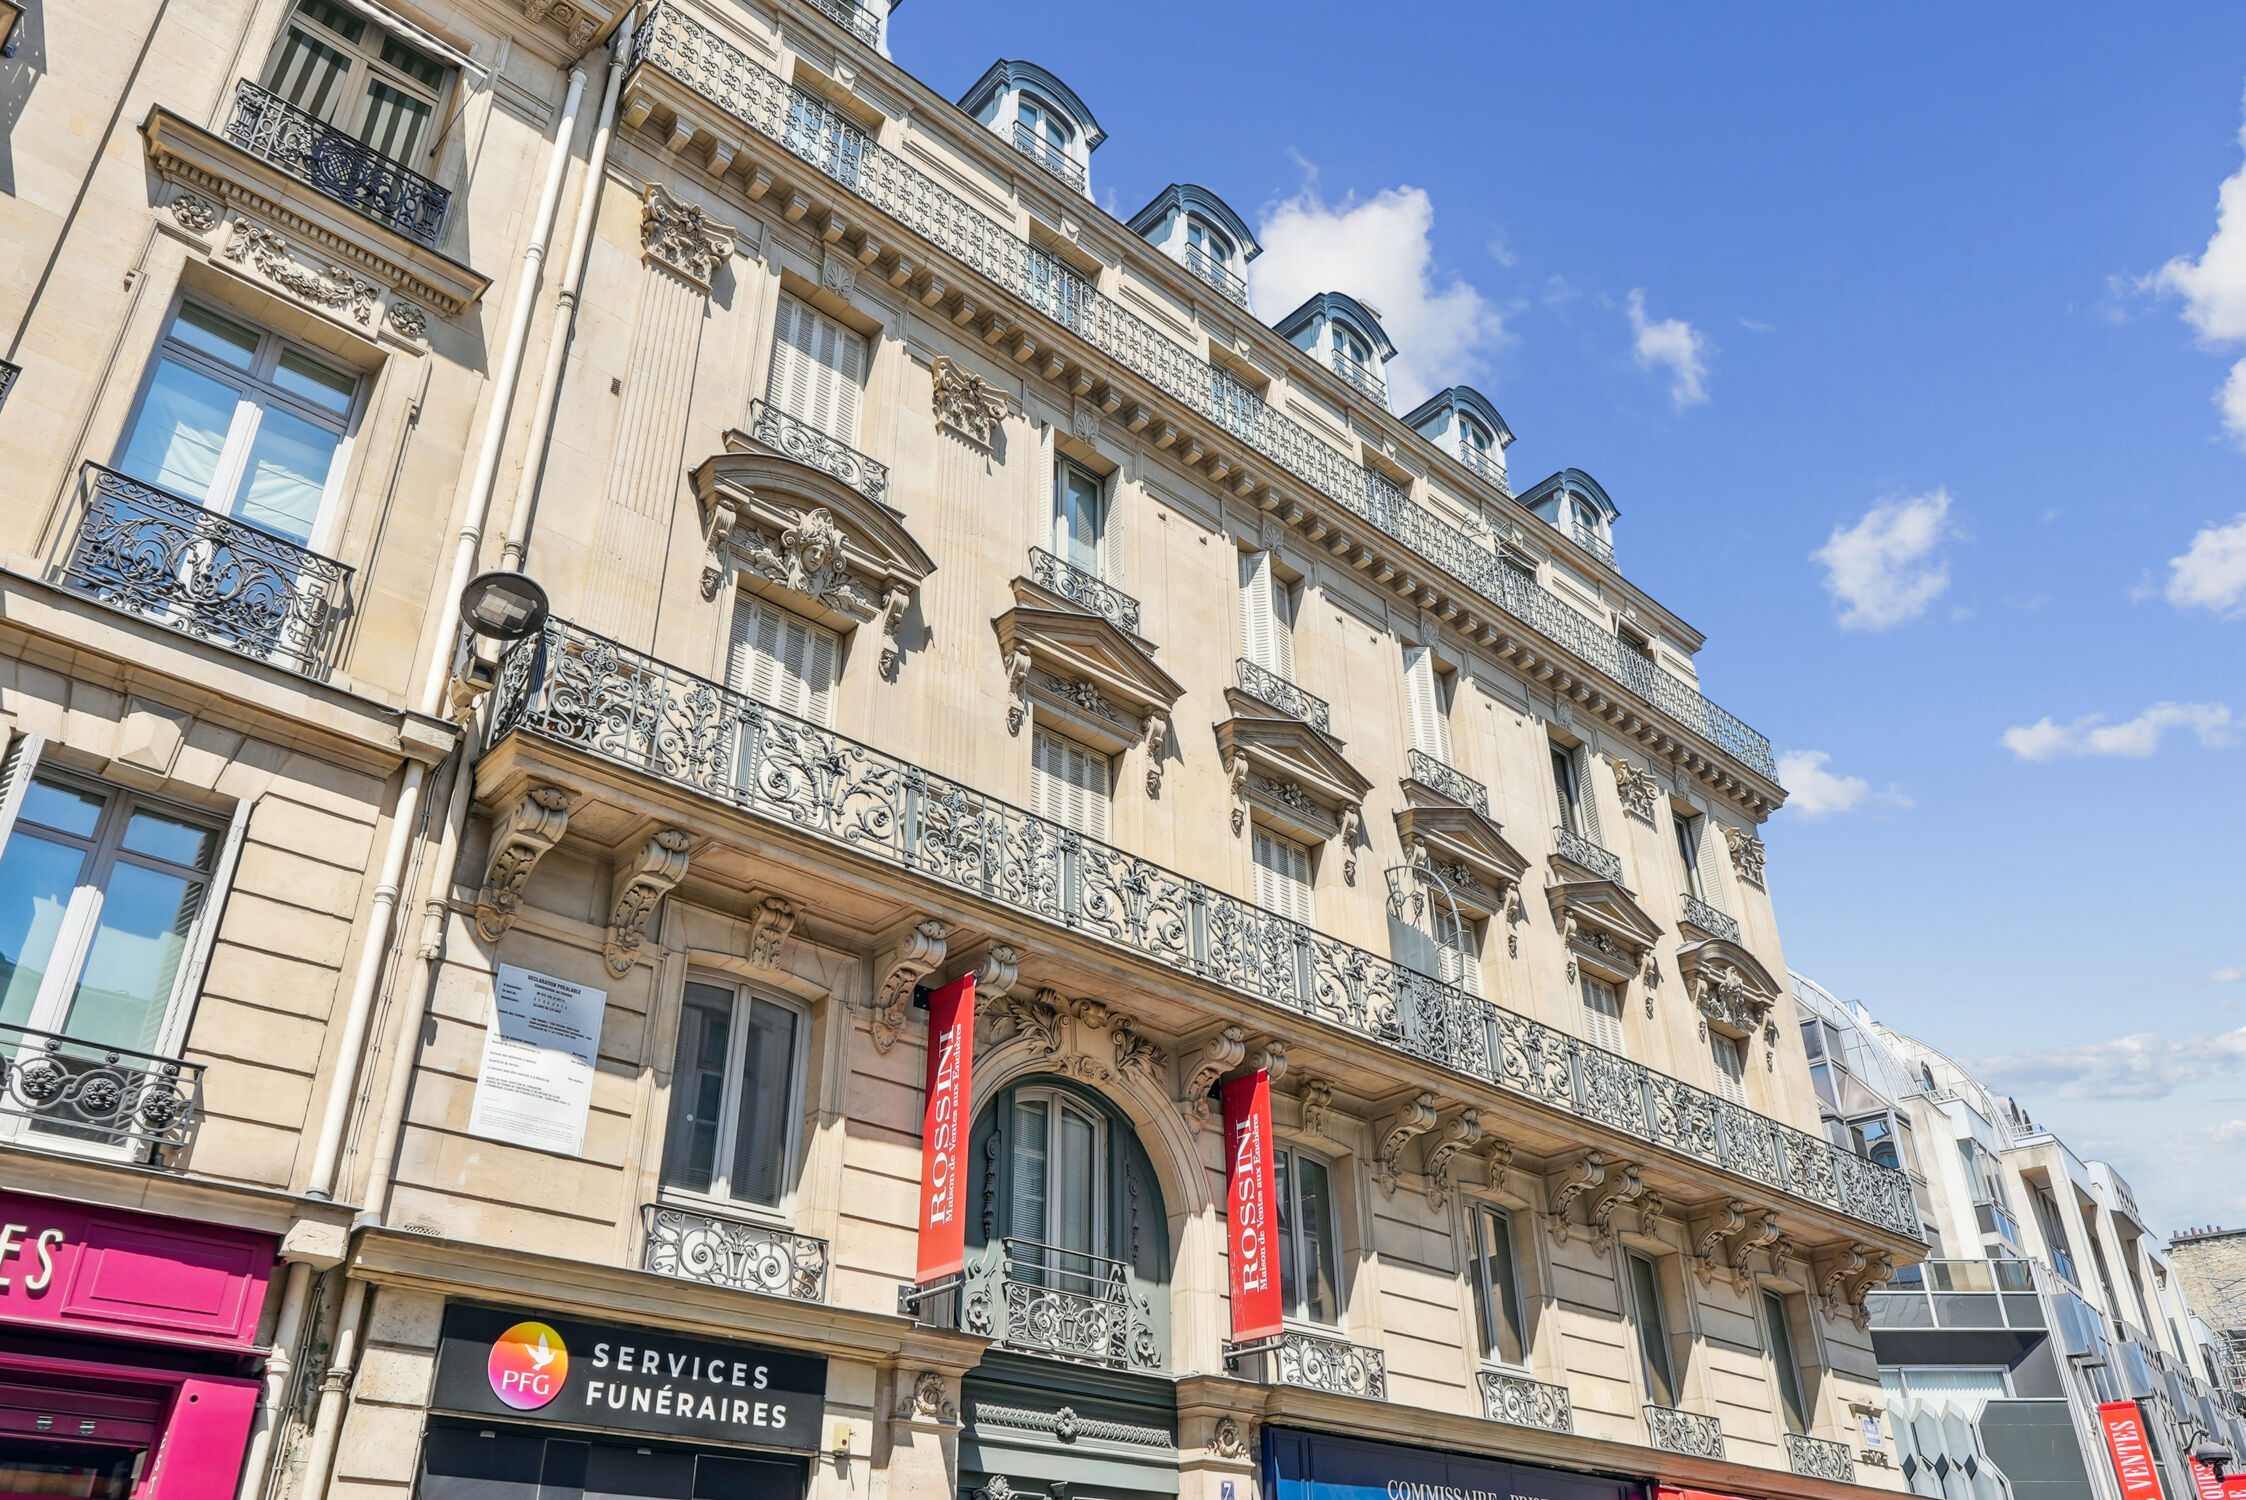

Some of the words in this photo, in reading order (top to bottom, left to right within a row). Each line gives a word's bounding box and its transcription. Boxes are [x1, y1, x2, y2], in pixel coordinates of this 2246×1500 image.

[952, 1023, 962, 1080] Enchères
[951, 1082, 960, 1107] aux
[930, 1025, 954, 1230] ROSSINI
[948, 1109, 958, 1153] Ventes
[1252, 1113, 1262, 1164] Enchères
[948, 1154, 956, 1172] de
[1254, 1166, 1262, 1188] aux
[944, 1173, 955, 1222] Maison
[1236, 1114, 1260, 1295] ROSSINI
[1255, 1191, 1264, 1229] Ventes
[1257, 1230, 1265, 1244] de
[1259, 1246, 1268, 1291] Maison
[501, 1370, 550, 1396] PFG
[592, 1342, 769, 1390] SERVICES
[585, 1380, 788, 1430] FUNÉRAIRES
[2109, 1420, 2152, 1491] VENTES
[1223, 1482, 1232, 1500] 7
